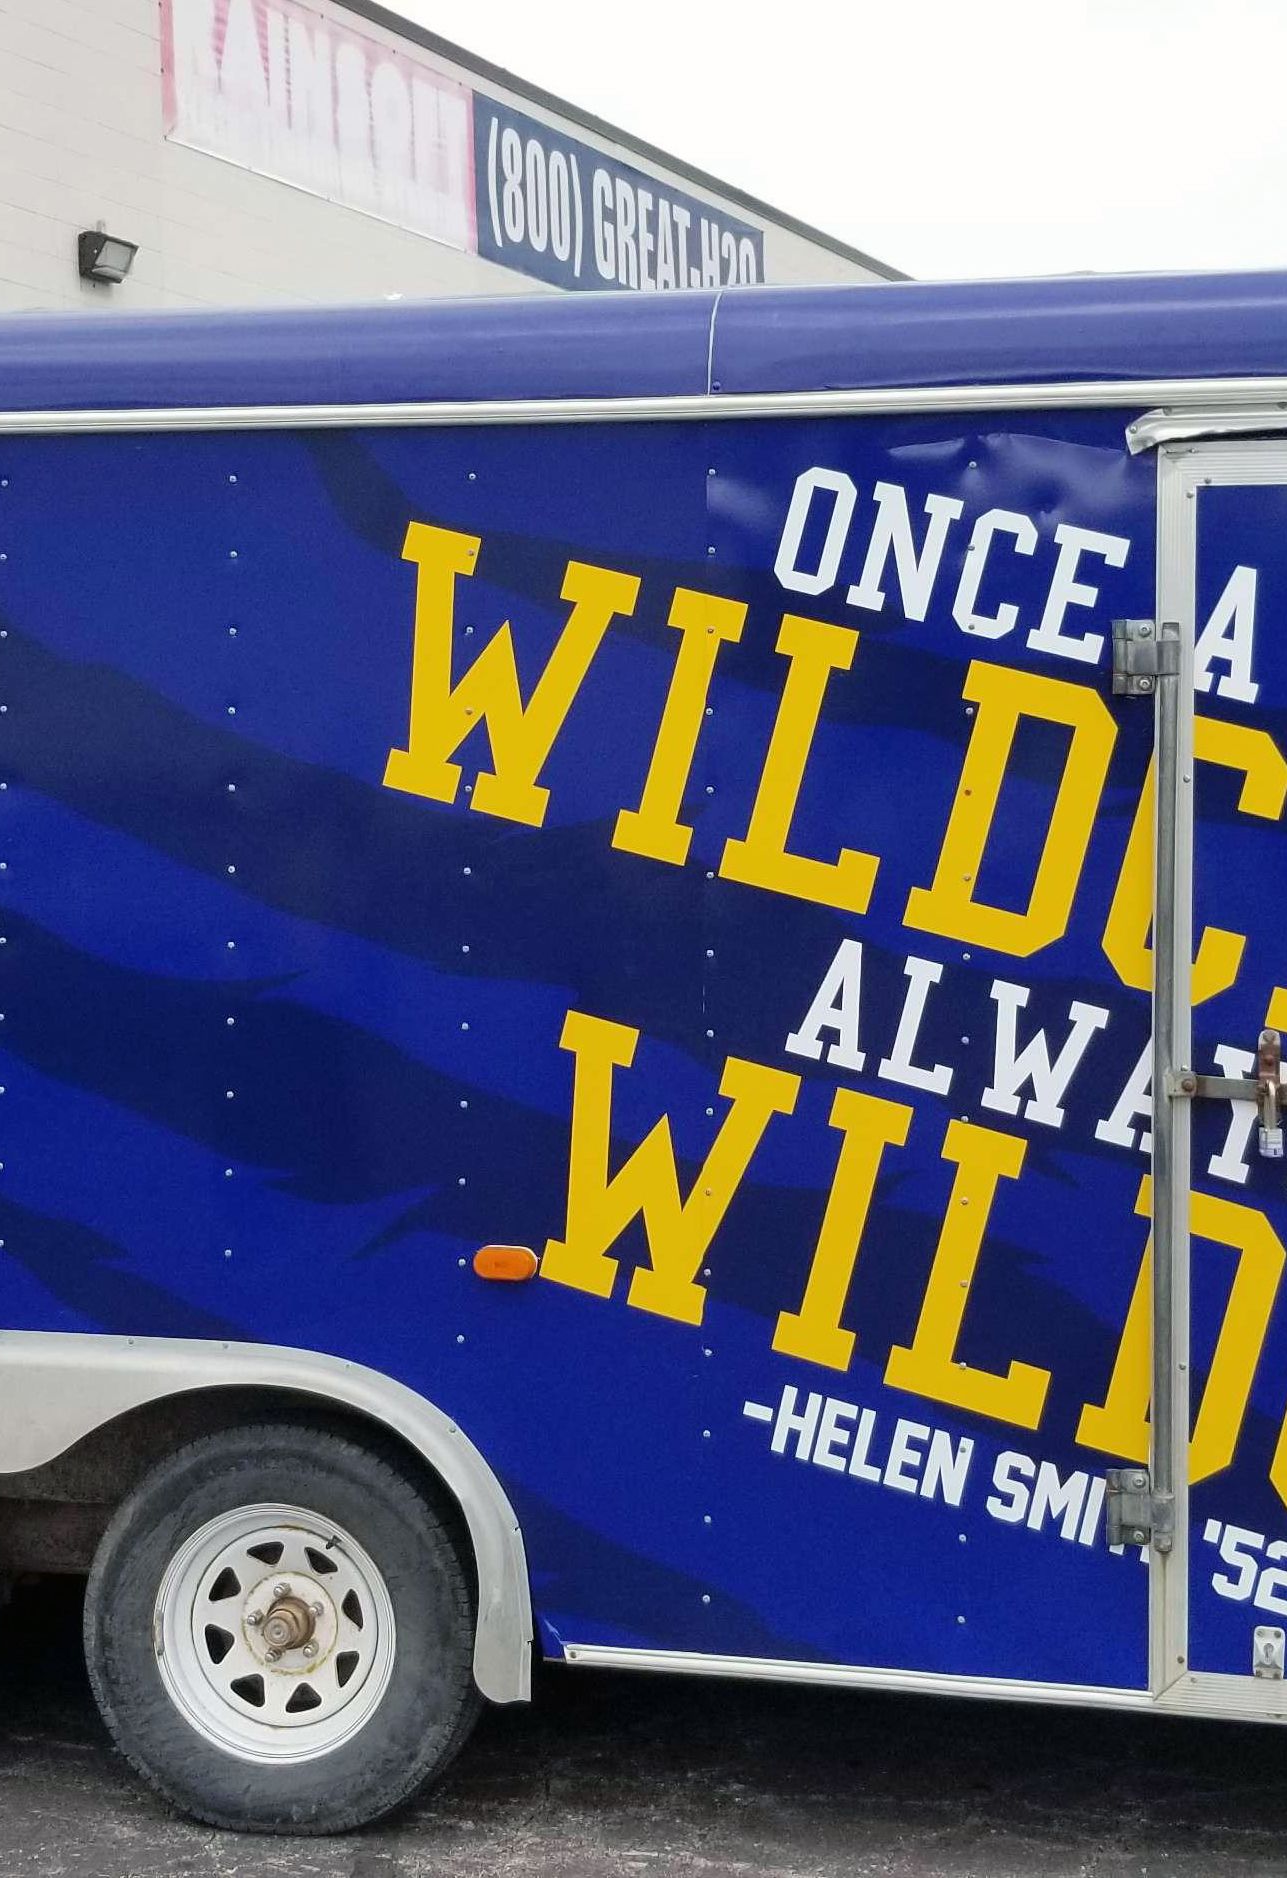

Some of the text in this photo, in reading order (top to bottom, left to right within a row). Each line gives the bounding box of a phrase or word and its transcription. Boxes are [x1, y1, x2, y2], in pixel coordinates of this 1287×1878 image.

[488, 116, 584, 277] (800)
[772, 466, 1260, 705] ONCE A
[743, 1384, 974, 1507] -HELEN
[985, 1450, 1150, 1565] SMI
